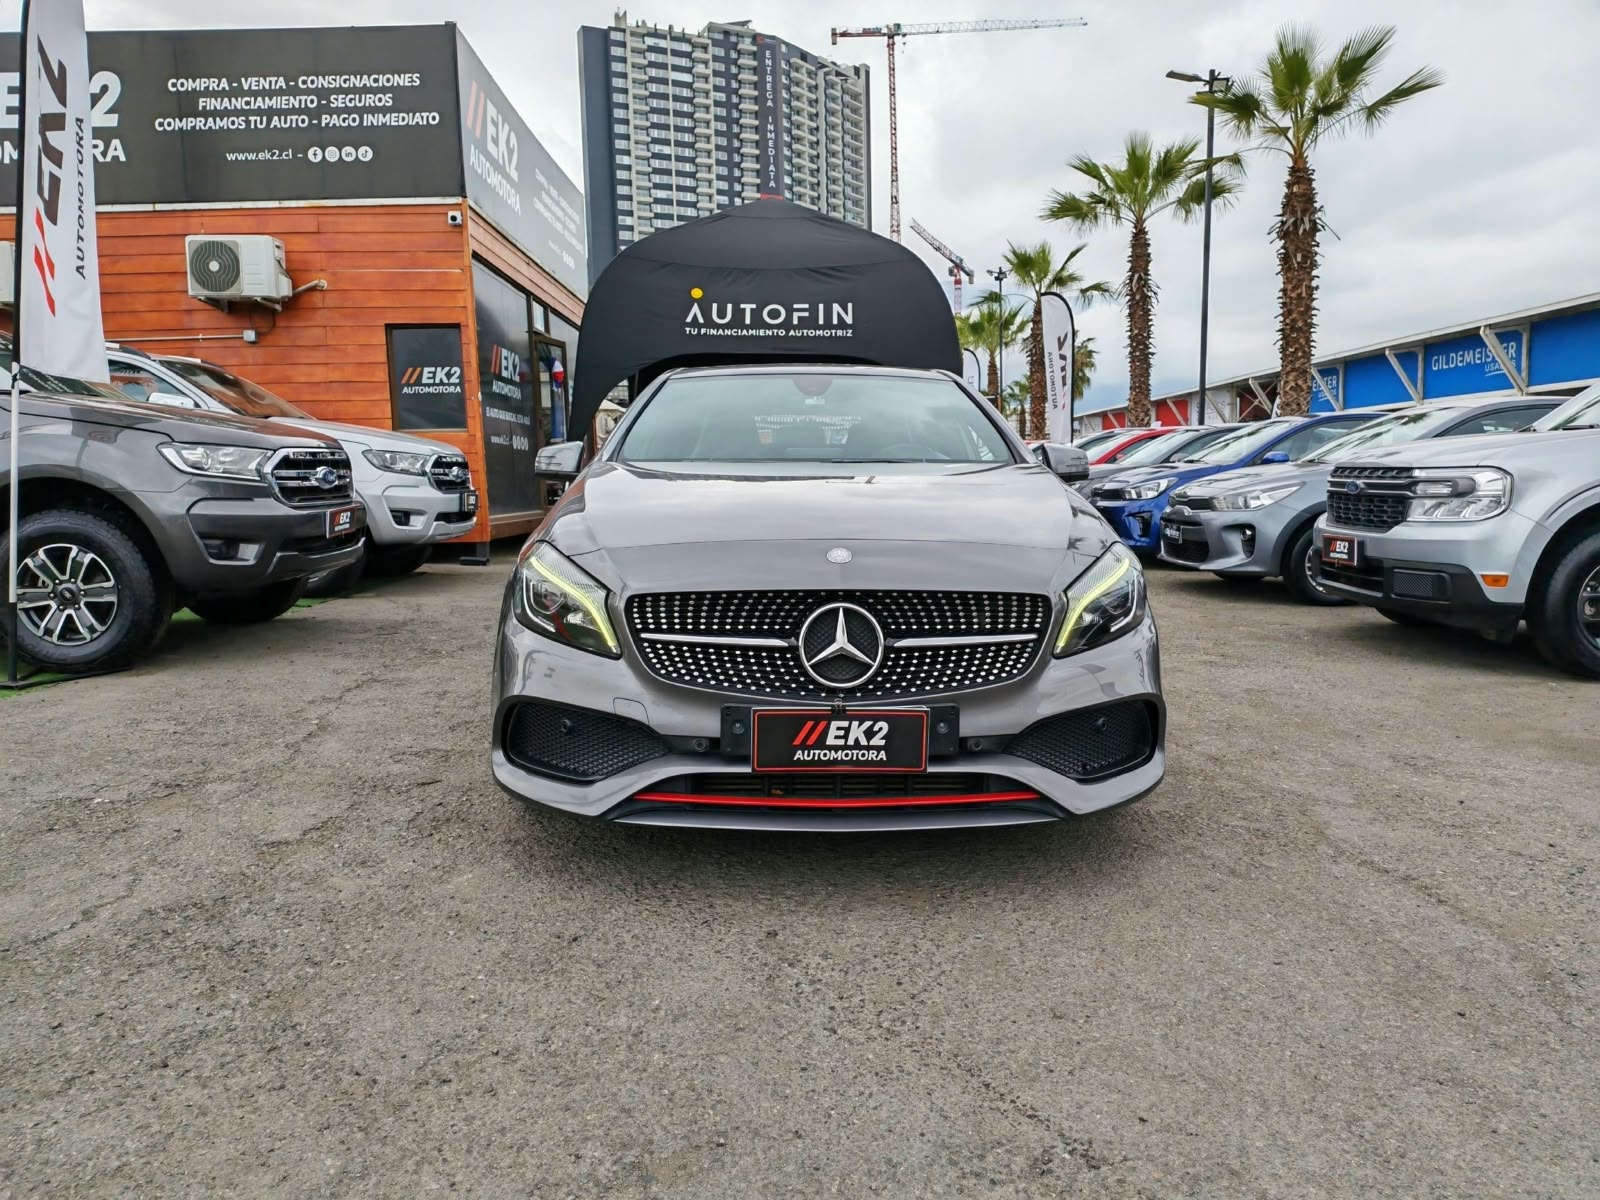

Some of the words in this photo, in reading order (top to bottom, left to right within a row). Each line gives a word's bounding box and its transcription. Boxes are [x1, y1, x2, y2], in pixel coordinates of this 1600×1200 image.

[167, 77, 229, 92] COMPRA
[241, 77, 286, 90] VENTA
[298, 73, 420, 89] CONSIGNACIONES
[765, 50, 774, 107] ENTREGA
[198, 95, 318, 110] FINANCIAMIENTO
[330, 93, 393, 108] SEGUROS
[154, 116, 246, 131] COMPRAMOS
[249, 115, 267, 129] TU
[270, 114, 309, 129] AUTO
[321, 113, 360, 127] PAGO
[362, 111, 440, 126] INMEDIATO
[486, 97, 518, 183] EK2
[226, 148, 292, 162] www.ek2.cl
[767, 116, 776, 188] INMEDIATA
[470, 143, 521, 216] AUTOMOTORA
[75, 117, 86, 280] AUTOMOTORA
[685, 302, 853, 325] AUTOFIN
[685, 327, 698, 335] TU
[700, 328, 786, 337] FINANCIAMIENTO
[788, 329, 853, 337] AUTOMOTRIZ
[501, 347, 520, 382] EK2
[1432, 341, 1517, 371] GILDEMEISER
[421, 366, 461, 384] EK2
[402, 385, 461, 394] AUTOMOTORA
[1336, 541, 1348, 552] EK2
[825, 720, 889, 746] EK2
[793, 749, 887, 761] AUTOMOTORA
